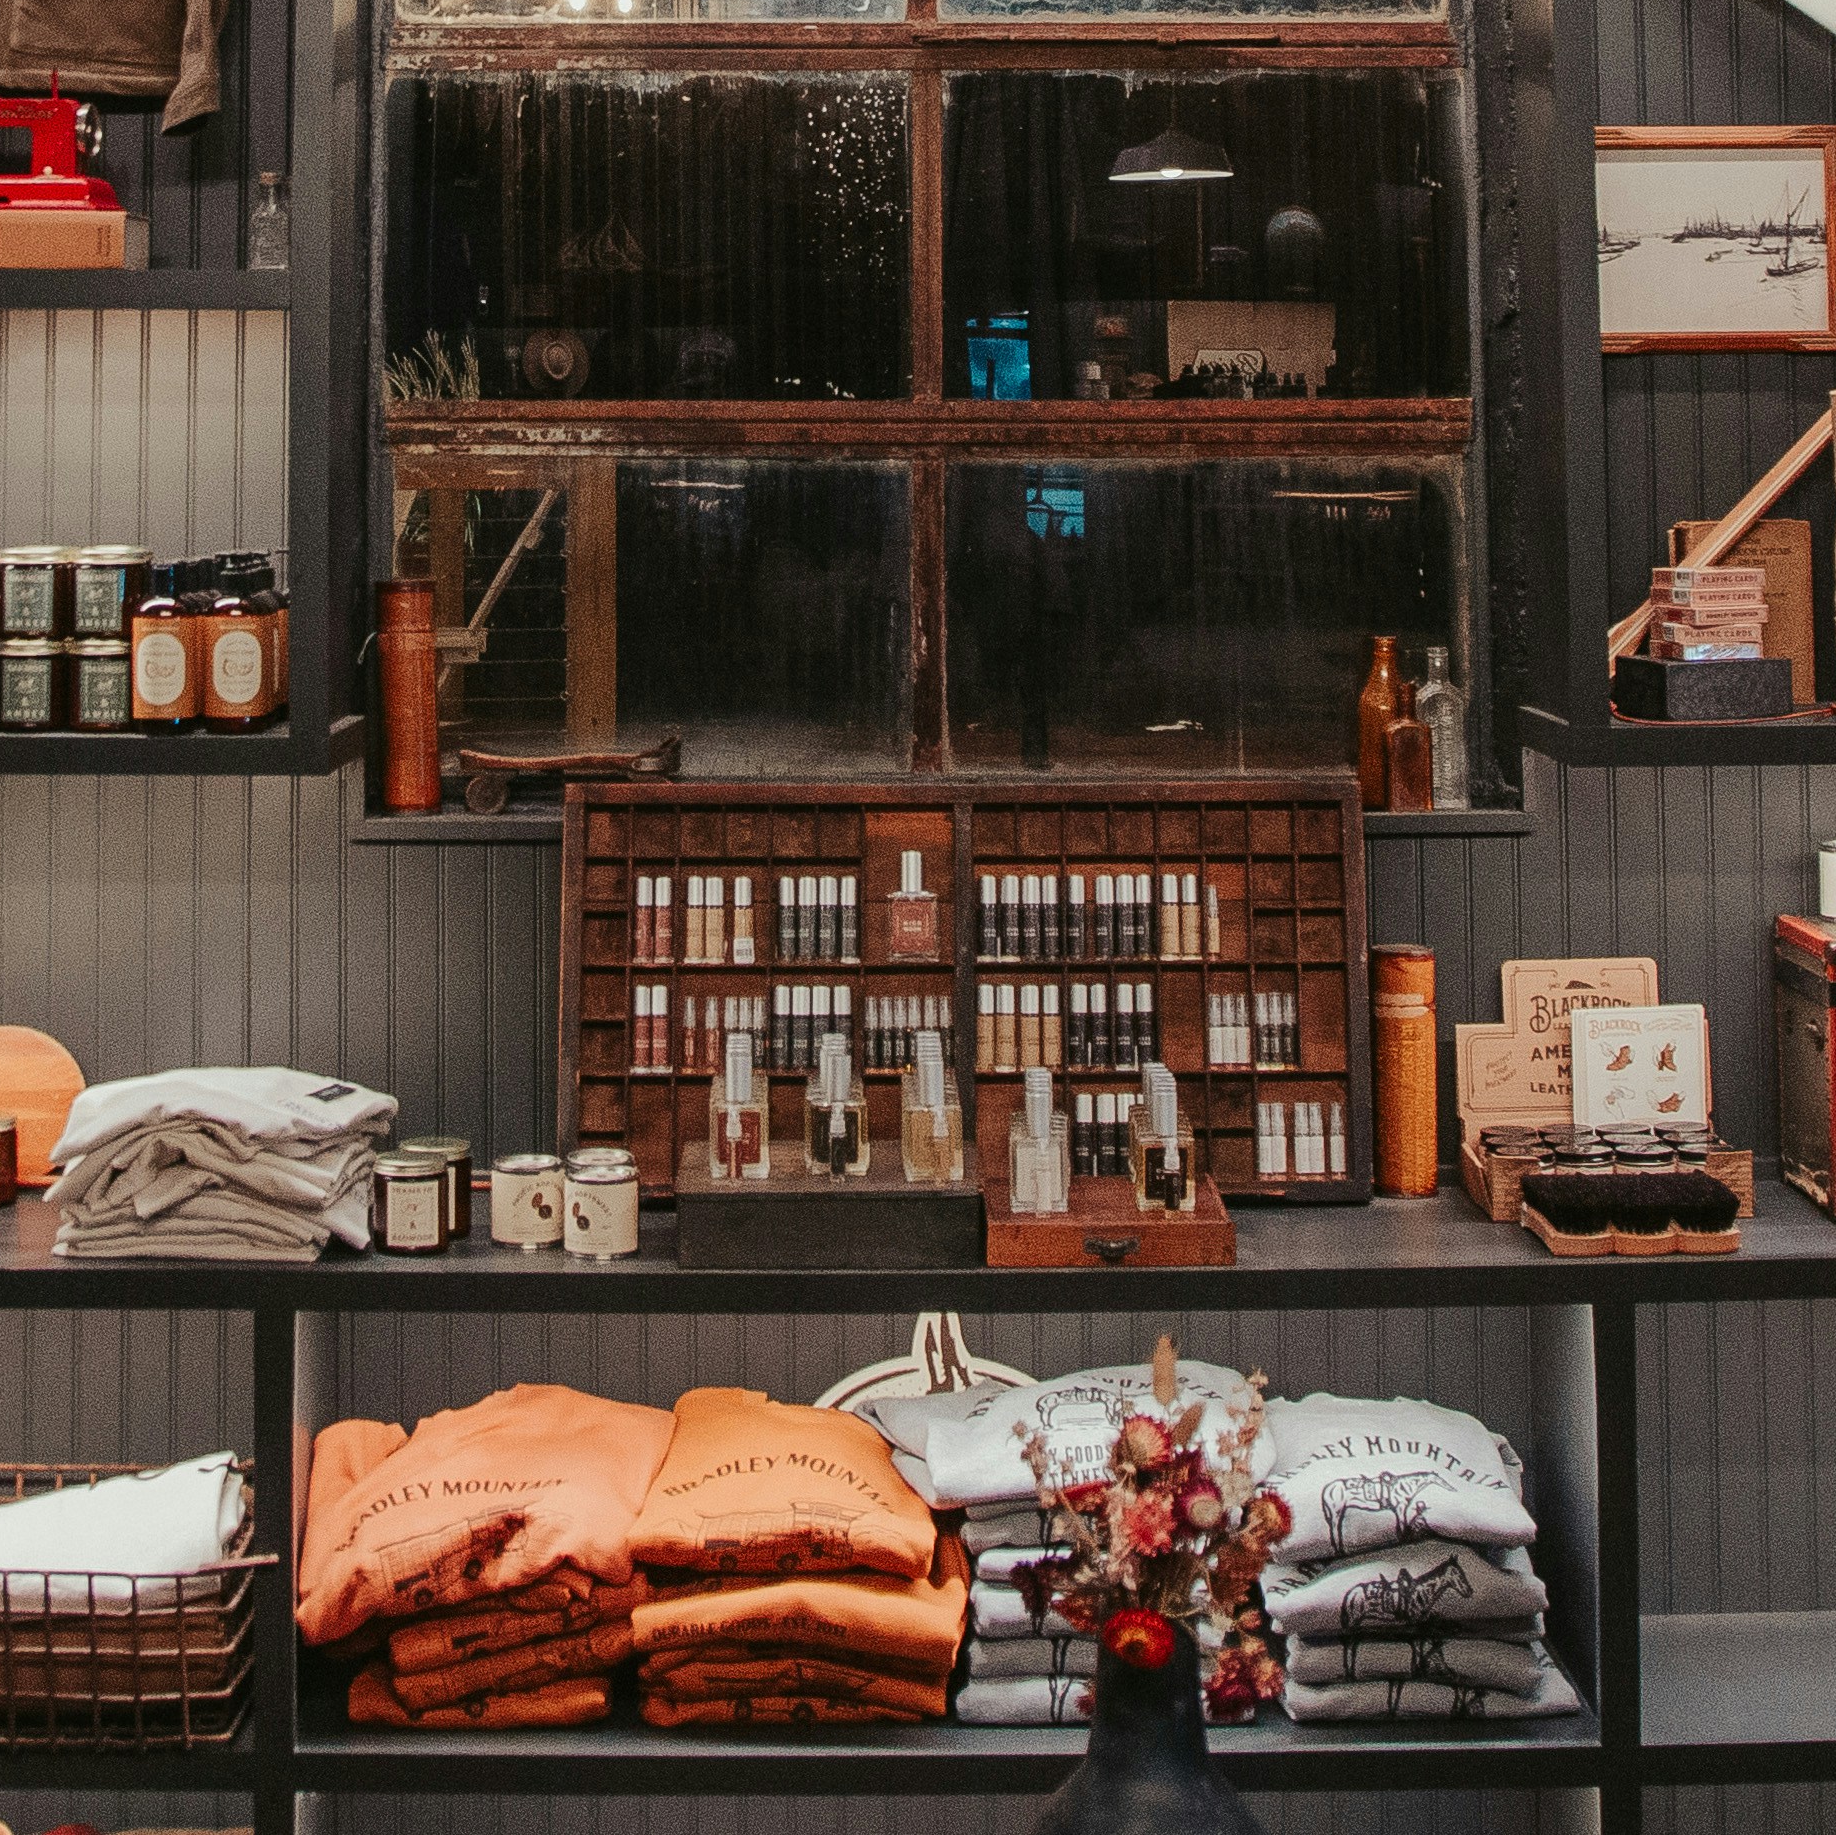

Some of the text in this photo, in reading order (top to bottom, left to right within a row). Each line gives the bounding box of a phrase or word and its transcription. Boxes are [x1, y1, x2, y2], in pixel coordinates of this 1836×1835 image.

[1701, 574, 1759, 584] PLAYING CARDS
[1698, 593, 1757, 602] PLAYING CARDS
[1684, 629, 1753, 638] PLAYING CARDS
[1589, 1019, 1643, 1040] BLACKROCK
[1364, 1435, 1510, 1490] MOUNTAIN
[661, 1455, 781, 1499] BRADLEY
[652, 1621, 716, 1641] DURABLE
[718, 1619, 768, 1637] GOODS
